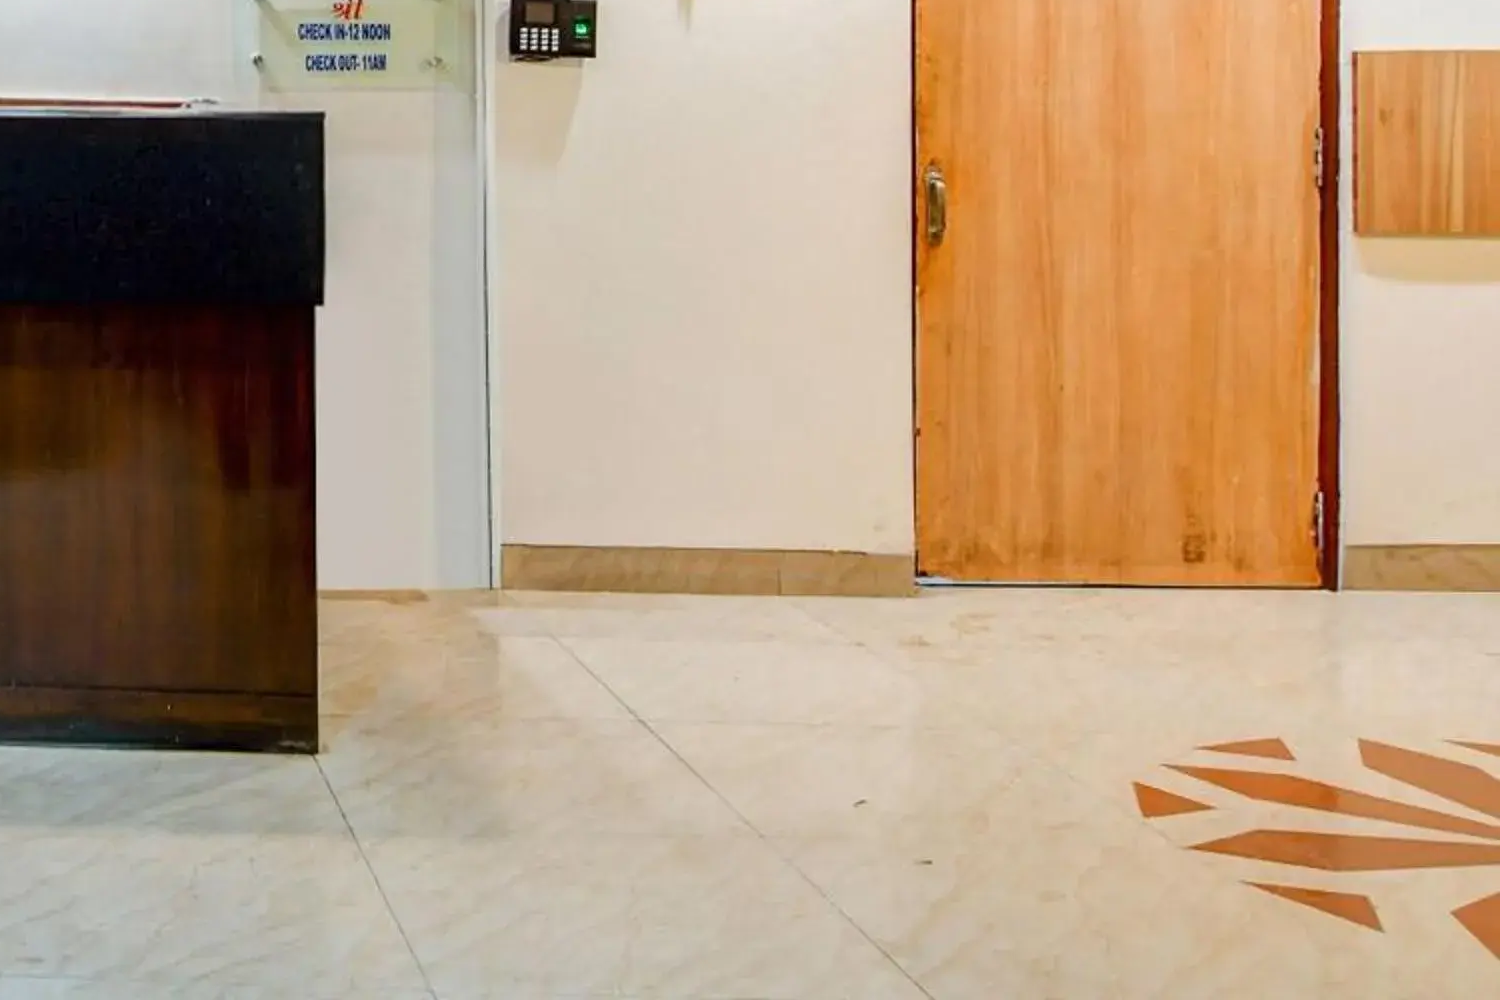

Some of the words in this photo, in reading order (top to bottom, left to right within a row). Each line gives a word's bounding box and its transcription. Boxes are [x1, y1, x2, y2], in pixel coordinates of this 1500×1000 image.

[298, 23, 332, 40] CHECK
[361, 23, 391, 41] NOON
[305, 54, 336, 71] CHECK
